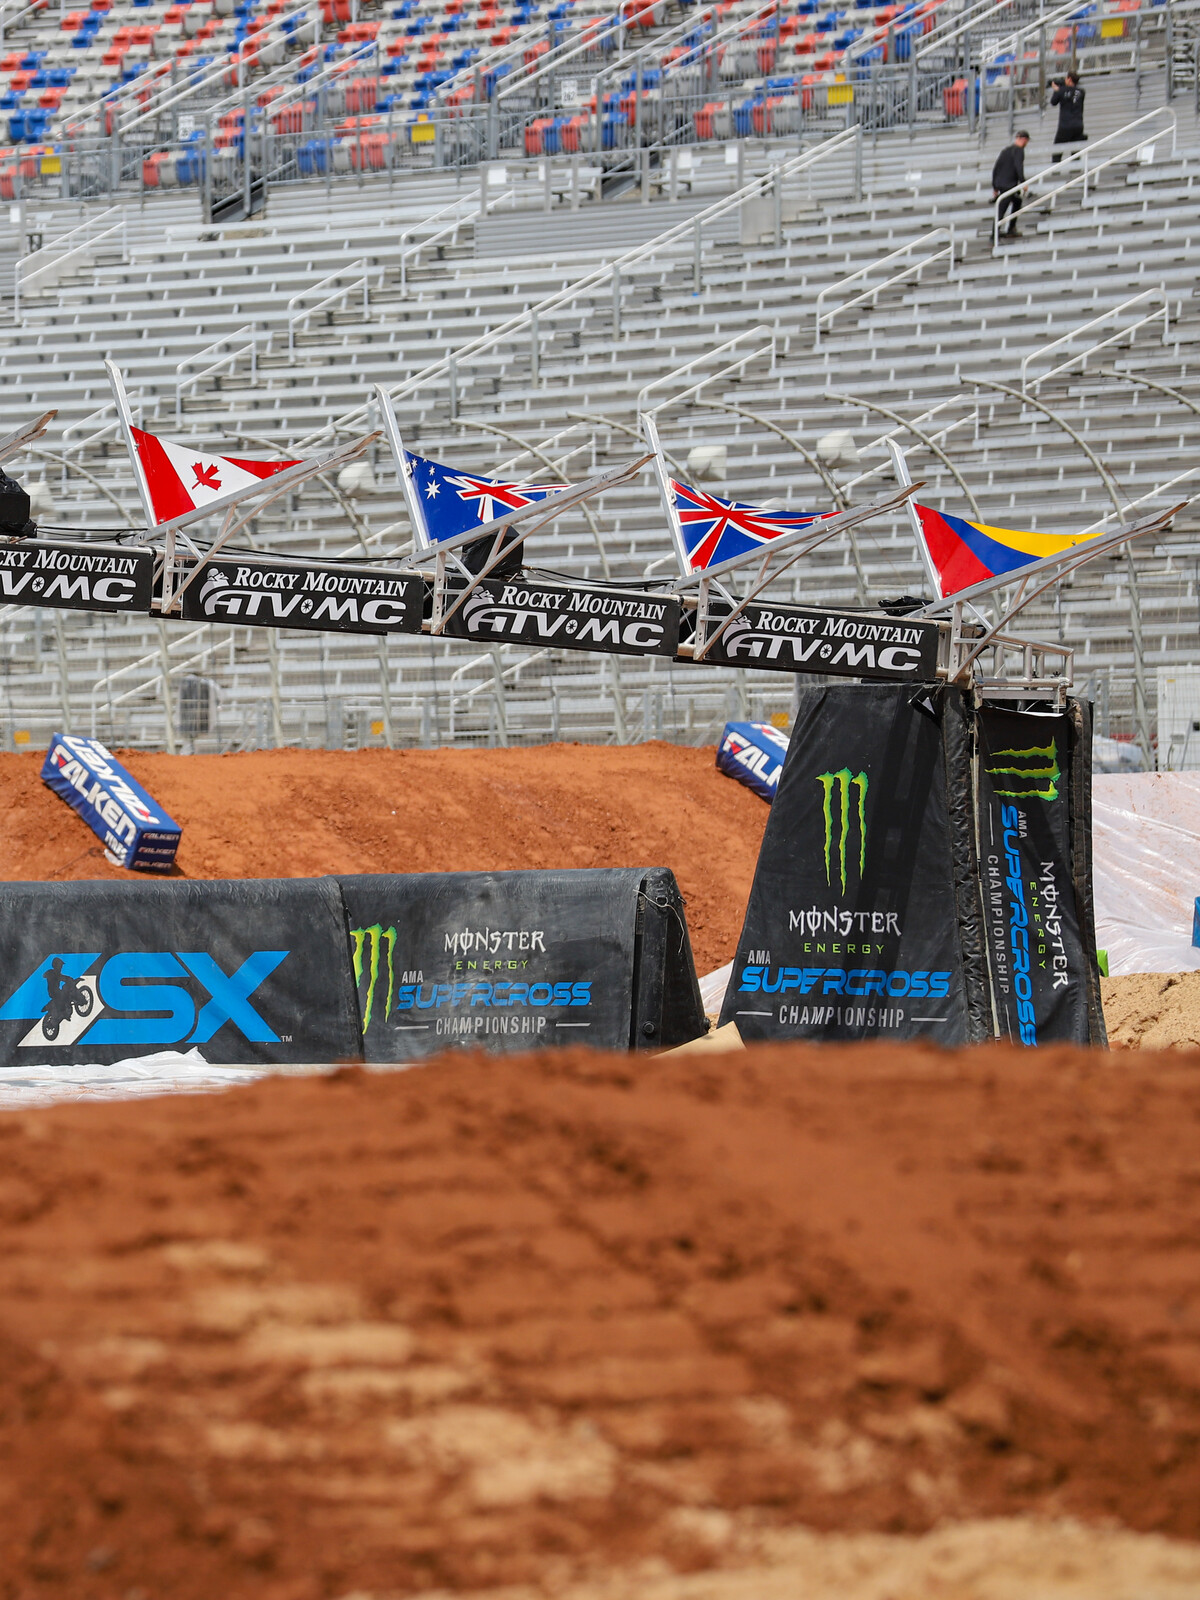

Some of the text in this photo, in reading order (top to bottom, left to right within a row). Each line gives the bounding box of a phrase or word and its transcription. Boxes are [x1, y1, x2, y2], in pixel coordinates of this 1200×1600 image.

[33, 549, 138, 574] MOUNTAIN
[233, 567, 408, 597] ROCKY MOUNTAIN
[498, 585, 666, 620] ROCKY MOUNTAIN
[755, 611, 924, 644] ROCKY MOUNTAIN
[50, 744, 137, 847] FALKEN
[1018, 810, 1027, 839] AMA
[987, 854, 1009, 994] CHAMPIONSHIP
[1002, 803, 1037, 1048] SUPERCROSS
[1030, 881, 1046, 970] ENERGY
[748, 950, 771, 964] AMA
[804, 942, 885, 955] ENERGY
[402, 970, 424, 983] AMA
[455, 960, 529, 970] ENERGY
[397, 982, 593, 1010] SUPERCROSS
[738, 966, 952, 998] SUPERCROSS
[436, 1016, 546, 1035] CHAMPIONSHIP
[779, 1005, 904, 1028] CHAMPIONSHIP
